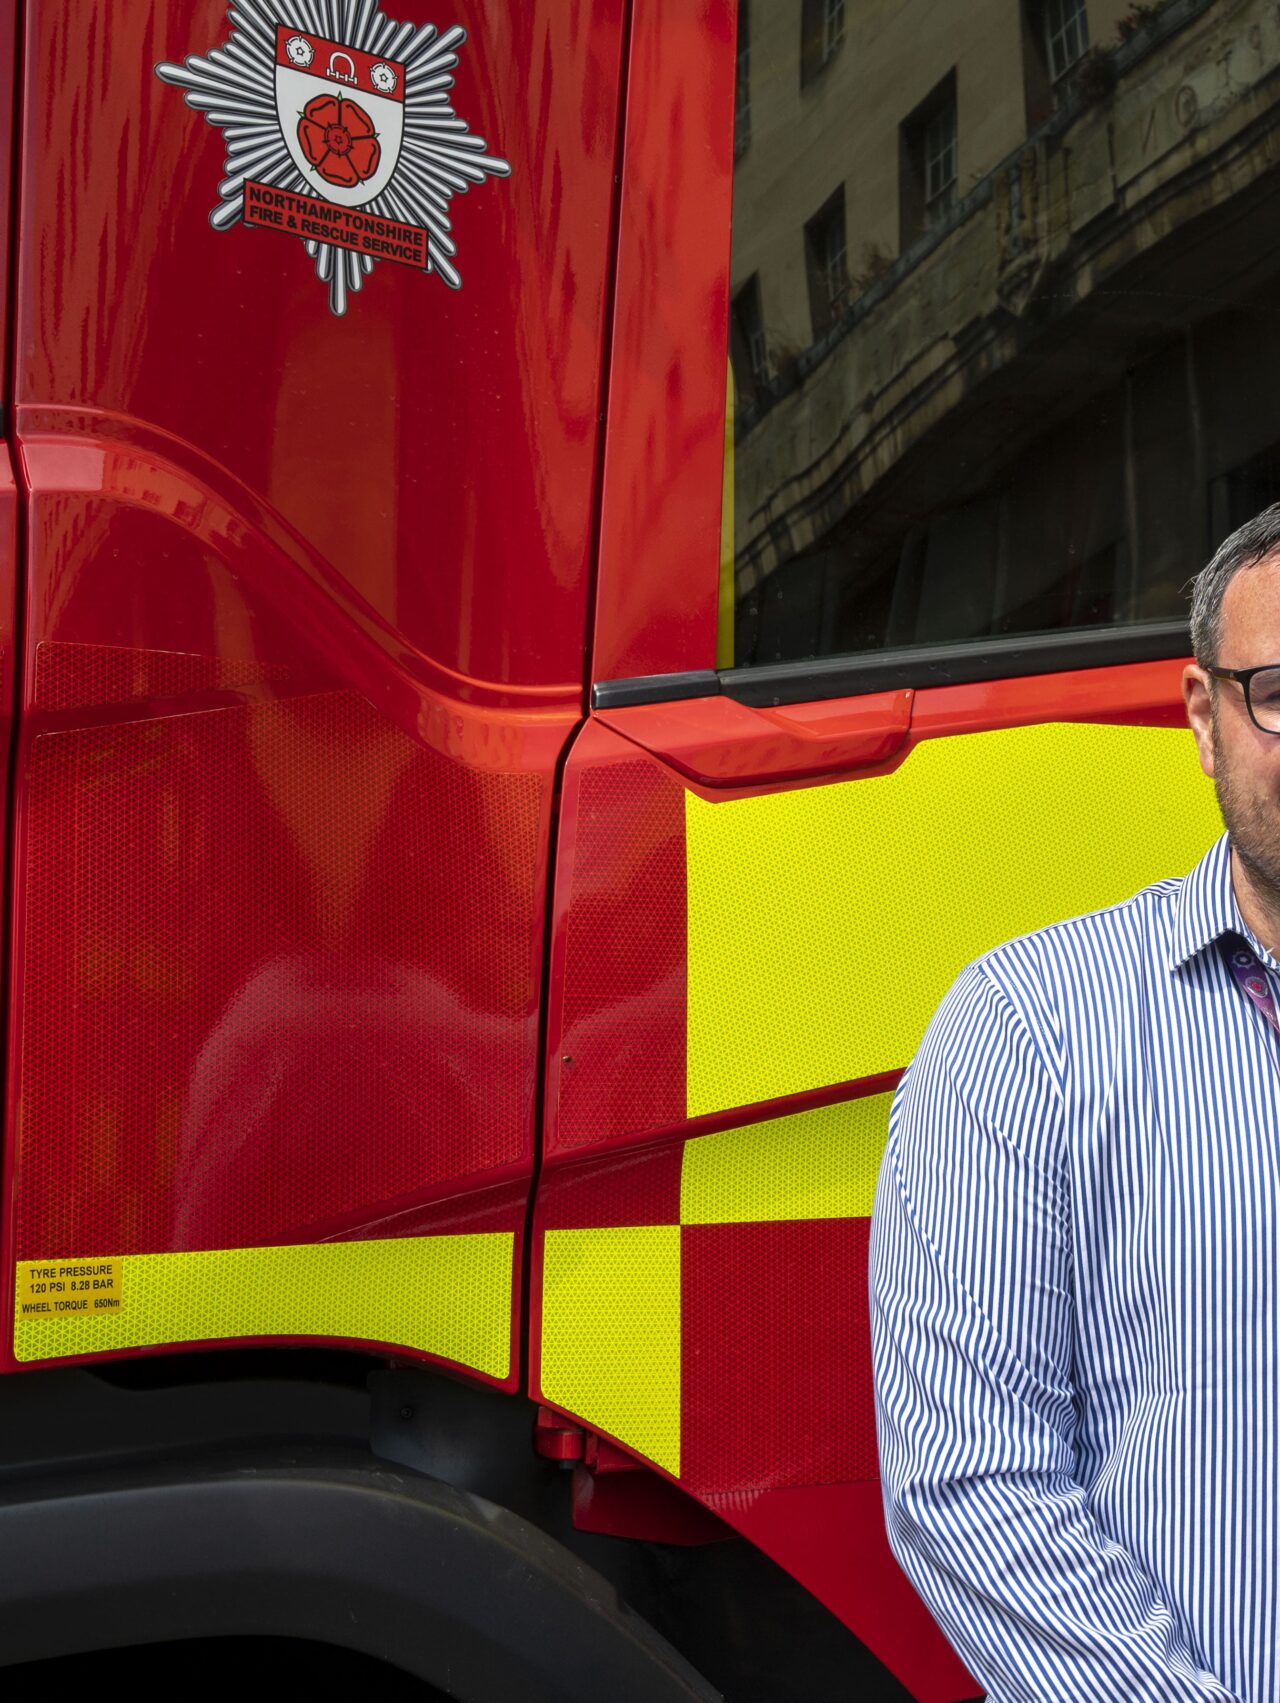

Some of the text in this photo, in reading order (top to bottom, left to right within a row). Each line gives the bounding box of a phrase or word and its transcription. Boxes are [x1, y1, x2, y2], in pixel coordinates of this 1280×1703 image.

[249, 186, 423, 247] NORTHAMPTONSHIRE
[249, 205, 422, 262] FIRE & RESCUE SERVICE
[30, 1265, 113, 1279] TYRE PRESSURE
[30, 1279, 114, 1293] 120 PSI 8.28 BAR
[22, 1298, 120, 1313] WHEEL TORQUE 650Nm
